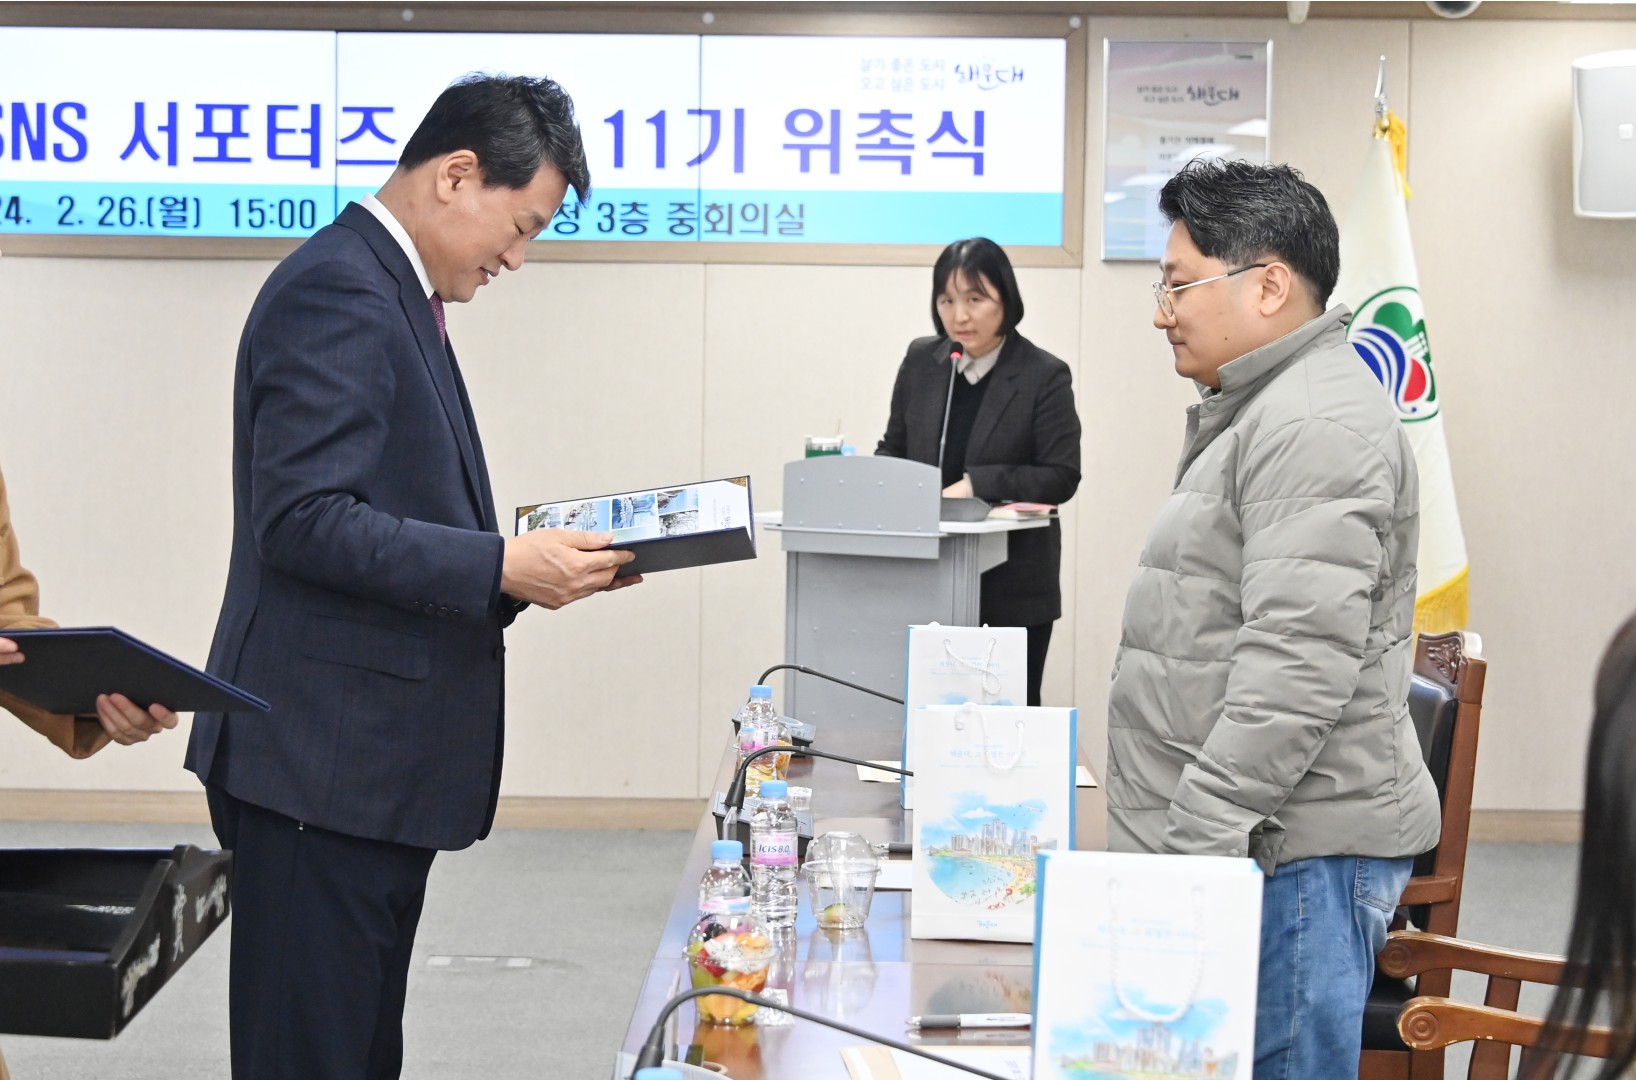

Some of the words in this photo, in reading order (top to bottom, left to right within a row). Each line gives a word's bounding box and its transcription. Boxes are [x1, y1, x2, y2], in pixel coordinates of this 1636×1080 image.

[0, 102, 88, 162] NS
[119, 102, 399, 168] 서포터즈
[603, 108, 745, 174] 11기
[782, 108, 985, 176] 위촉식
[0, 195, 32, 226] 4.
[230, 198, 317, 229] 15:00
[597, 202, 649, 235] 3층
[667, 202, 805, 236] 중회의실
